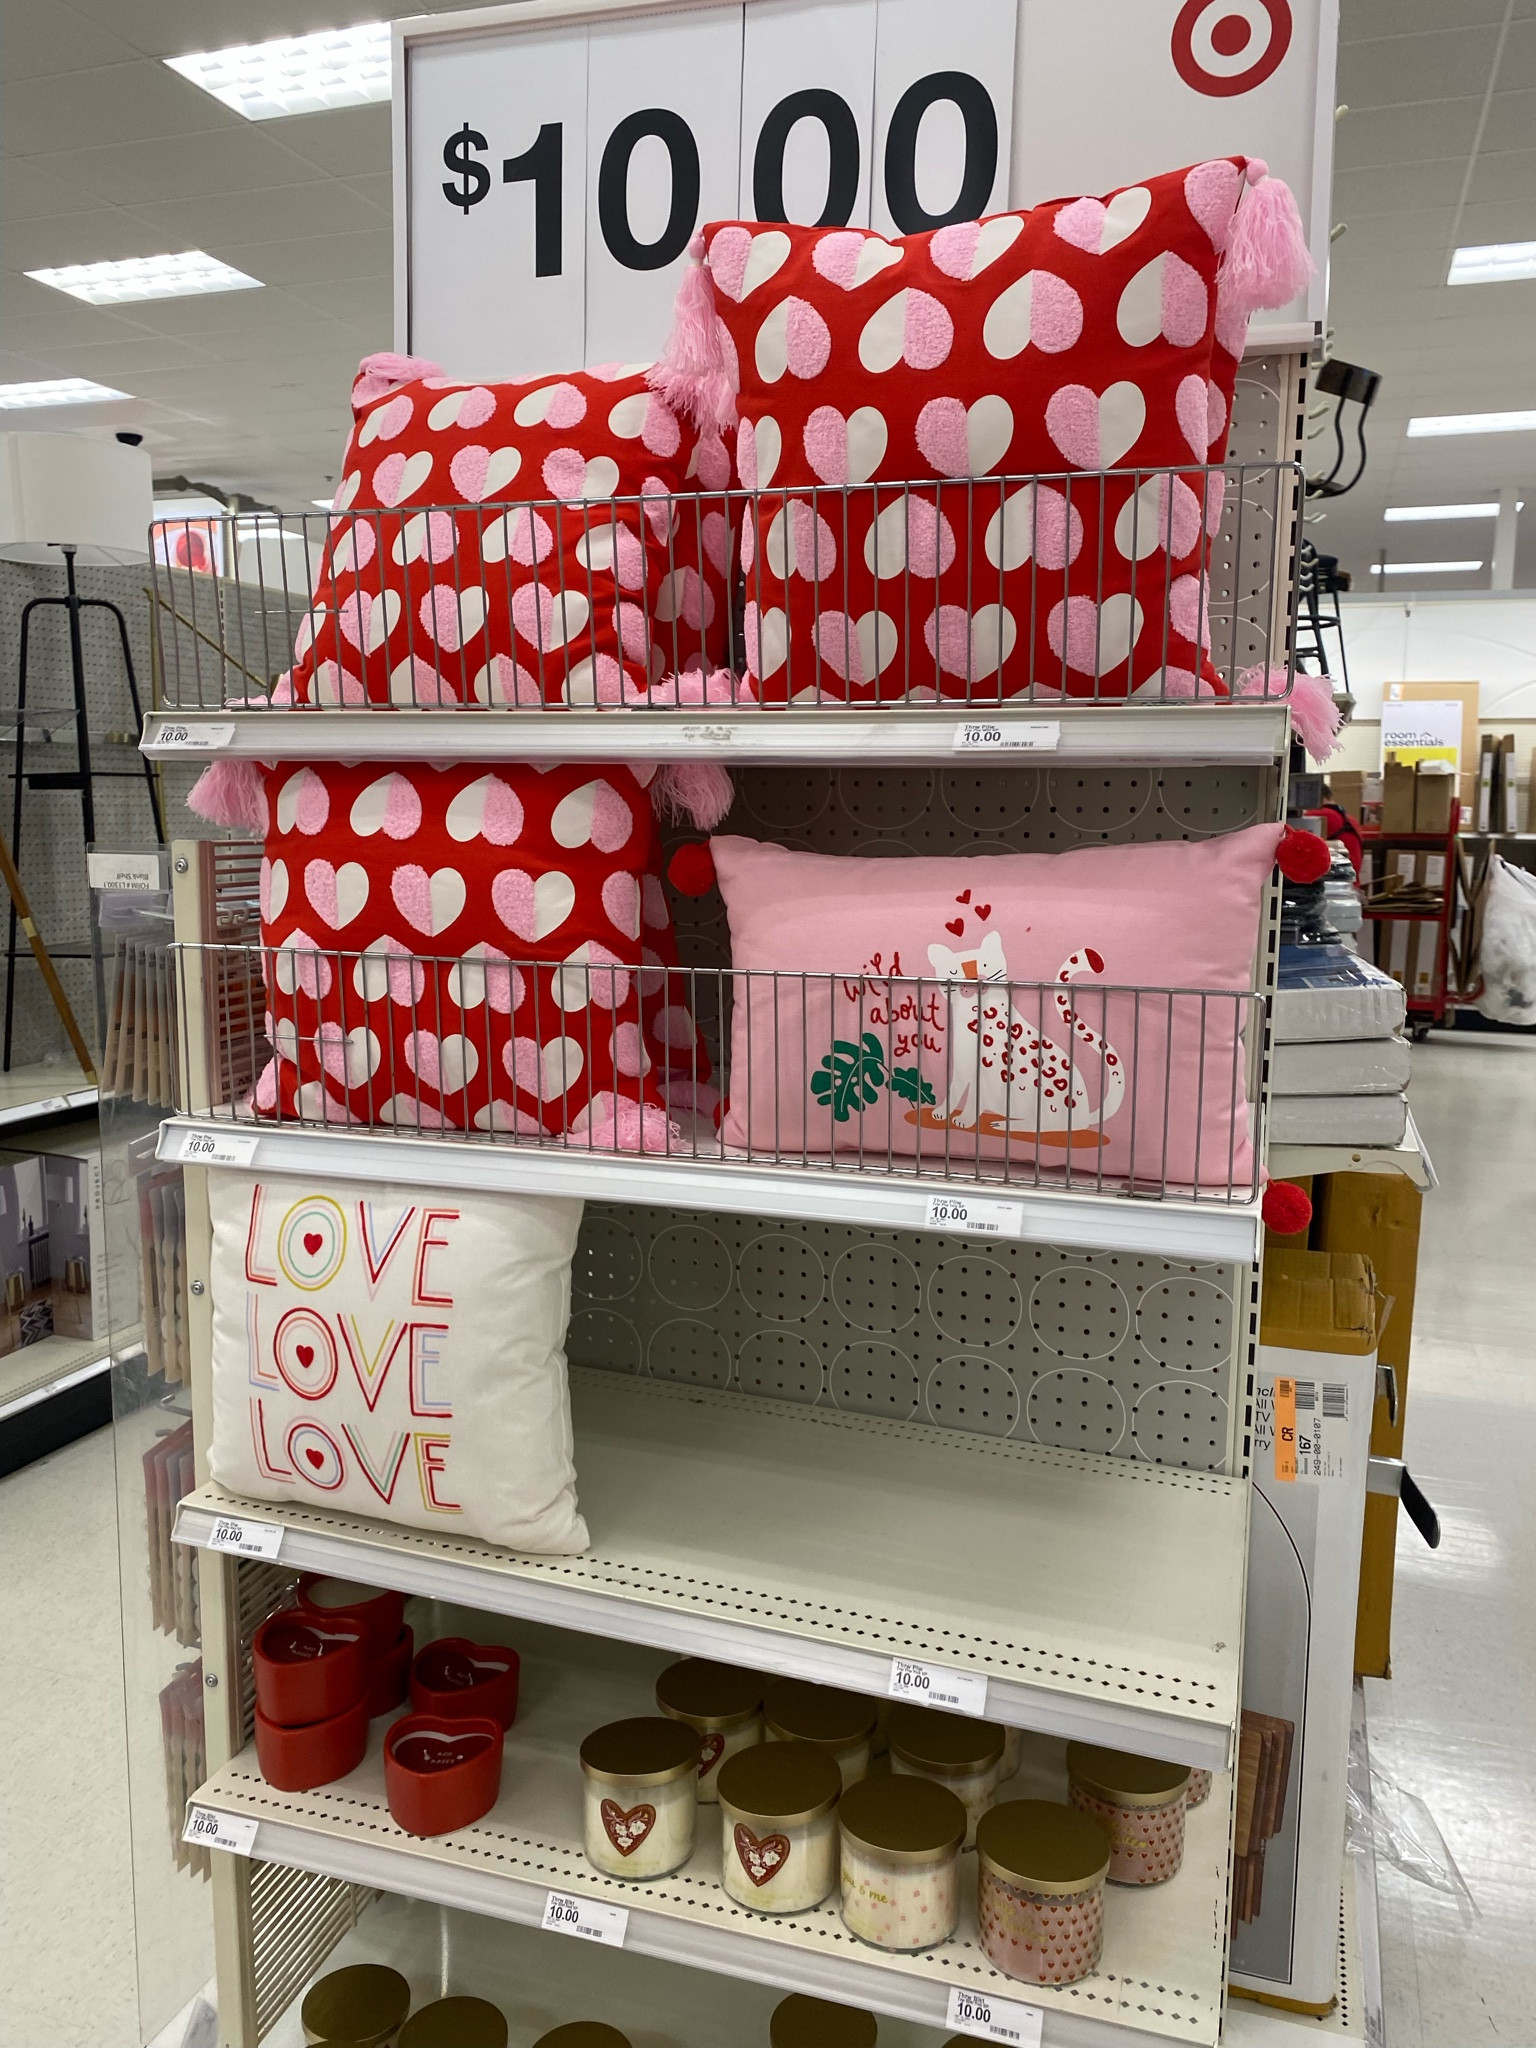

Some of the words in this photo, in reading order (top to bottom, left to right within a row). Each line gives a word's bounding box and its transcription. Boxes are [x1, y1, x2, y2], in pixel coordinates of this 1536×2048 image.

[160, 732, 188, 741] 10.00
[963, 731, 1001, 742] 10.00
[1384, 737, 1444, 747] essentials
[870, 993, 945, 1031] about
[894, 1033, 942, 1057] you
[188, 1141, 216, 1153] 10.00
[932, 1206, 968, 1221] 10.00
[245, 1183, 460, 1308] LOVE
[246, 1290, 453, 1418] LOVE
[1281, 1426, 1294, 1442] CR
[1298, 1435, 1312, 1455] 167
[1313, 1417, 1322, 1476] 249-00-0107
[249, 1396, 464, 1514] LOVE
[216, 1528, 243, 1542] 10.00
[896, 1671, 930, 1690] 10.00
[193, 1819, 219, 1835] 10.00
[869, 1890, 888, 1904] me
[550, 1905, 579, 1923] 10.00
[957, 2002, 991, 2023] 10.00
